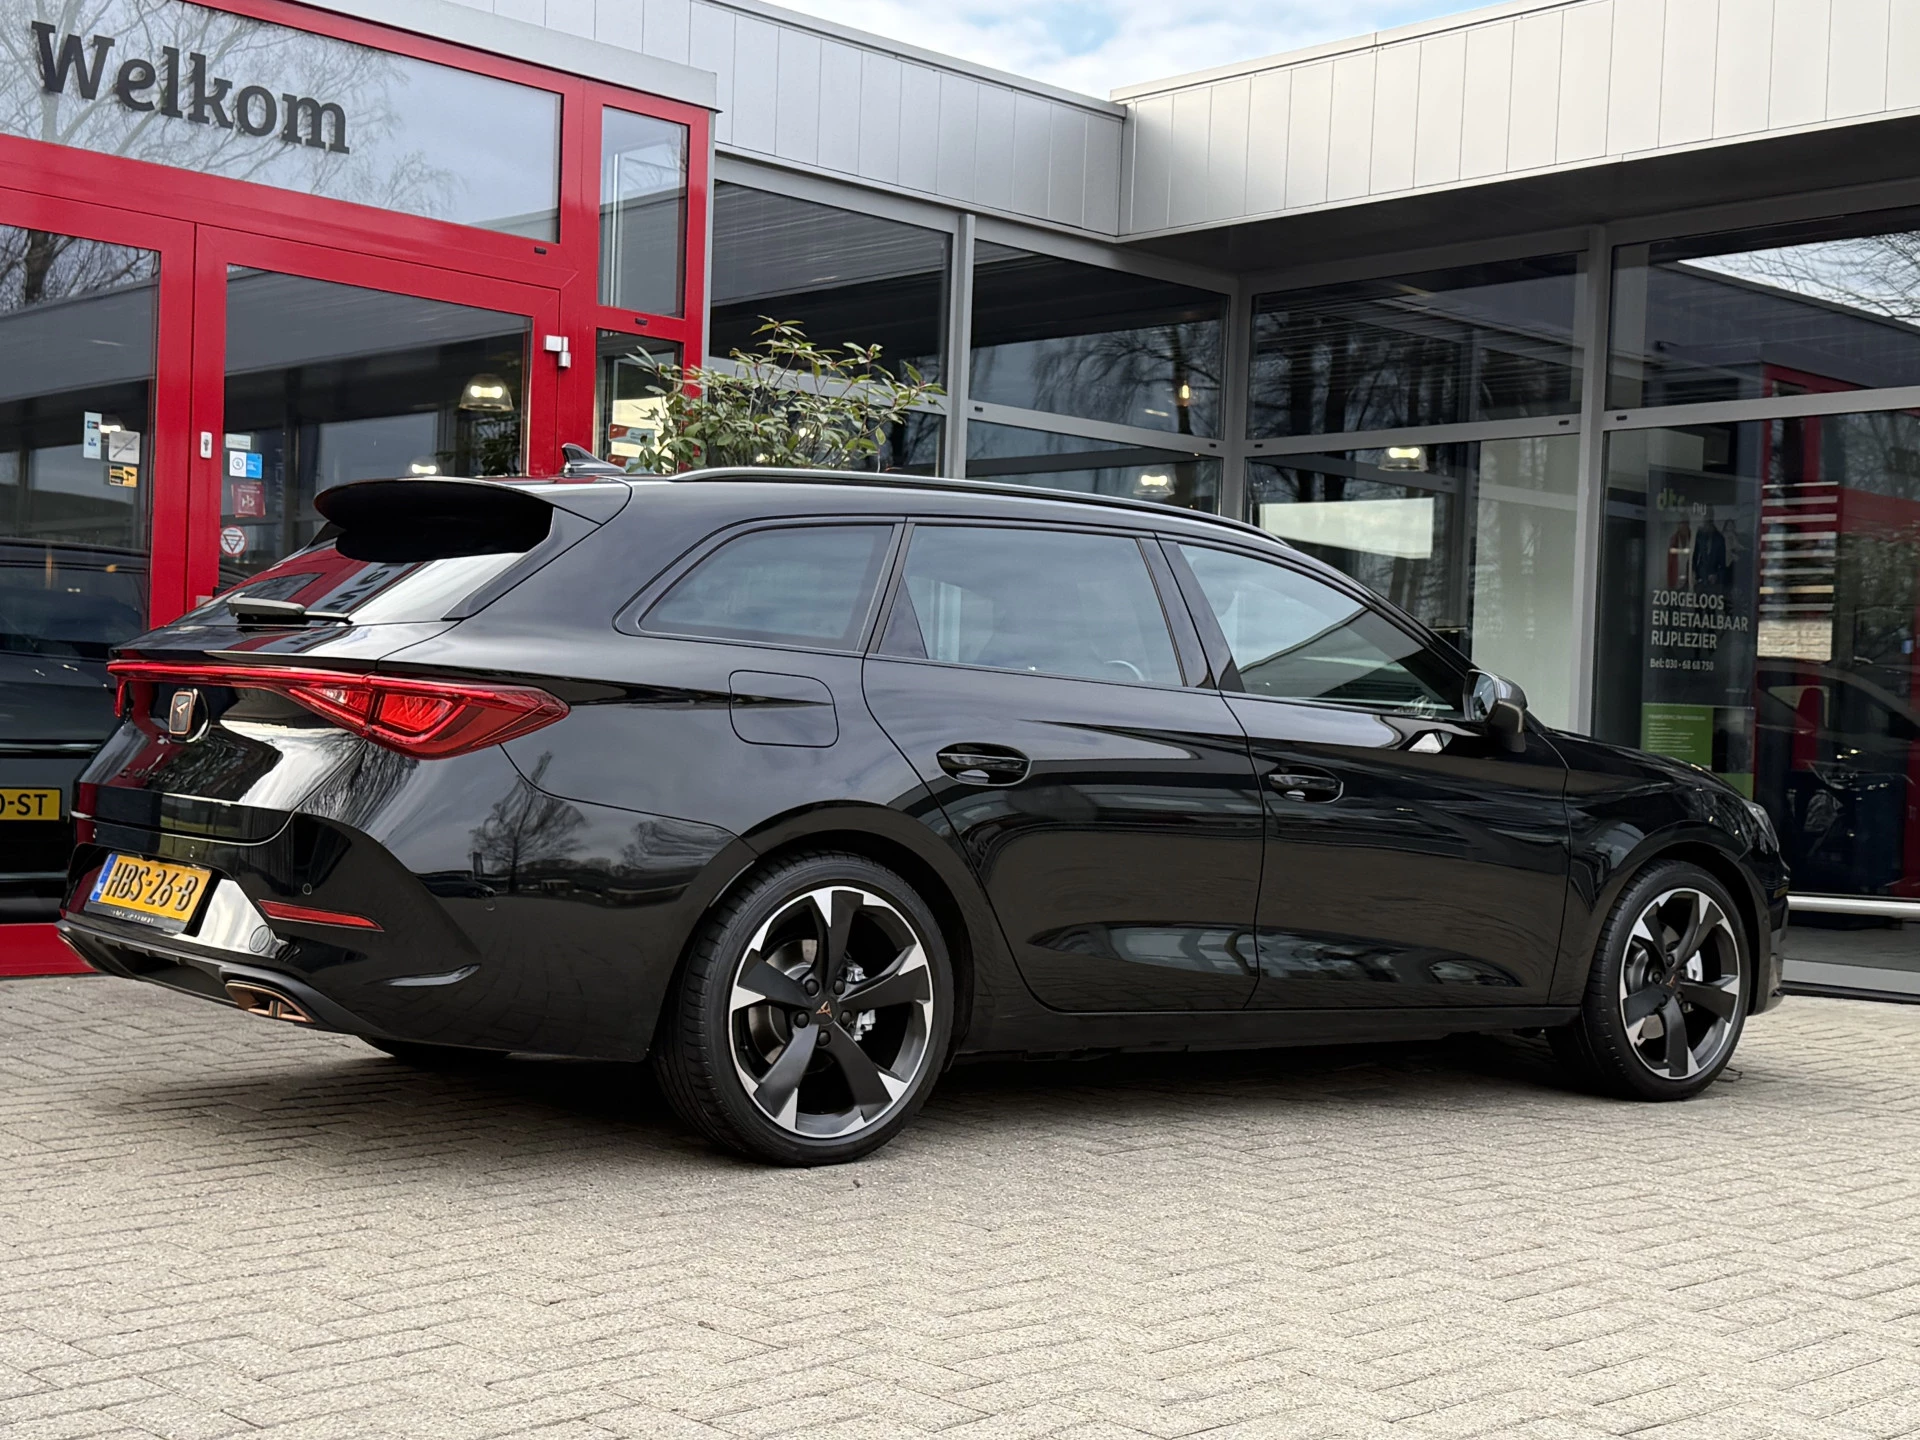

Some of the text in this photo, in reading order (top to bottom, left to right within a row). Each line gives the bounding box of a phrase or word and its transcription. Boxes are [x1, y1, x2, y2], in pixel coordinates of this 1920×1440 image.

[31, 20, 351, 154] Welkom
[1652, 589, 1725, 610] ZORGELOOS
[1651, 609, 1749, 632] EN BETAALBAAR
[1651, 629, 1718, 649] RIJPLEZIER
[105, 862, 199, 911] HBS-26-B
